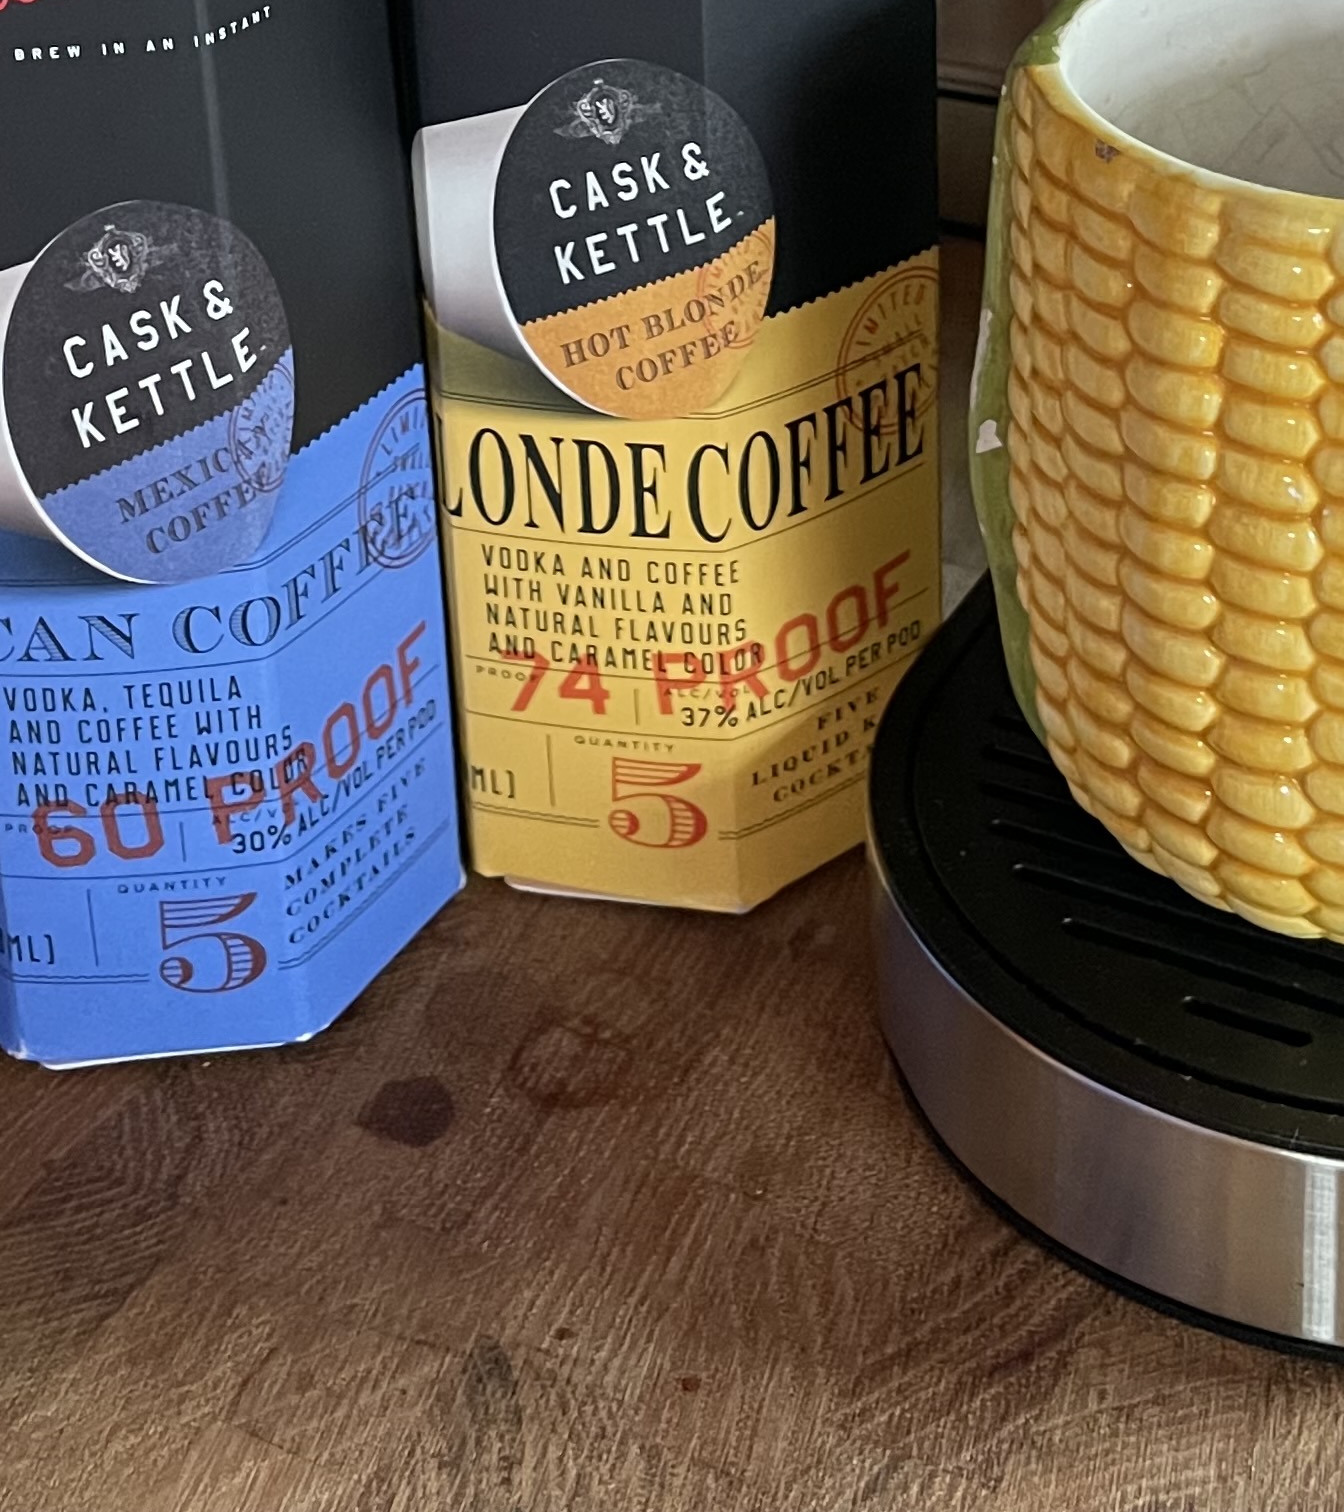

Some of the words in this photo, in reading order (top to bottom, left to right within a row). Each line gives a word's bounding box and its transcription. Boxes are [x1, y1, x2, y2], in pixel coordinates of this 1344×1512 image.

[14, 44, 81, 61] BREW
[193, 5, 272, 48] INSTANT
[548, 151, 671, 219] CASK
[681, 141, 710, 182] &
[554, 190, 733, 285] KETTLE
[63, 294, 193, 380] CASK
[202, 278, 235, 321] &
[560, 323, 633, 369] HOT
[642, 259, 762, 342] BLONDE
[71, 325, 258, 449] KETTLE
[614, 319, 741, 392] COFFEE
[687, 363, 924, 543] COFFEE
[481, 543, 566, 577] VODKA
[581, 556, 631, 583] AND
[646, 558, 741, 586] COFFEE
[484, 574, 544, 604] WITH
[556, 583, 666, 614] VANILLA
[681, 592, 733, 616] AND
[486, 602, 600, 639] NATURAL
[614, 617, 748, 647] FLAVOURS
[488, 632, 536, 660] AND
[550, 639, 668, 673] CARAMEL
[682, 641, 765, 676] COLOR
[499, 649, 611, 715] 74
[652, 548, 912, 715] PROOF
[123, 675, 243, 710] TEQUILA
[680, 705, 739, 728] 37%
[746, 666, 840, 722] ALC/VOL
[845, 641, 881, 677] PER
[886, 619, 921, 654] POD
[816, 686, 880, 731] FIVE
[9, 719, 61, 745] AND
[78, 713, 179, 744] COFFEE
[196, 703, 263, 735] WITH
[12, 747, 139, 776] NATURAL
[154, 724, 294, 771] FLAVOURS
[31, 792, 165, 867] 60
[206, 621, 428, 845] PROOF
[573, 734, 676, 754] QUANTITY
[751, 729, 850, 787] LIQUID
[16, 780, 68, 809] AND
[84, 770, 213, 807] CARAMEL
[230, 745, 309, 797] COLOR
[232, 824, 292, 855] 30%
[298, 764, 374, 838] ALC/VOL
[376, 726, 406, 770] PER
[608, 755, 708, 849] 5
[117, 876, 227, 894] QUANTITY
[284, 813, 367, 891] MAKES
[286, 804, 409, 917] COMPLETE
[289, 826, 416, 945] COCKTAILS
[159, 891, 268, 993] 5
